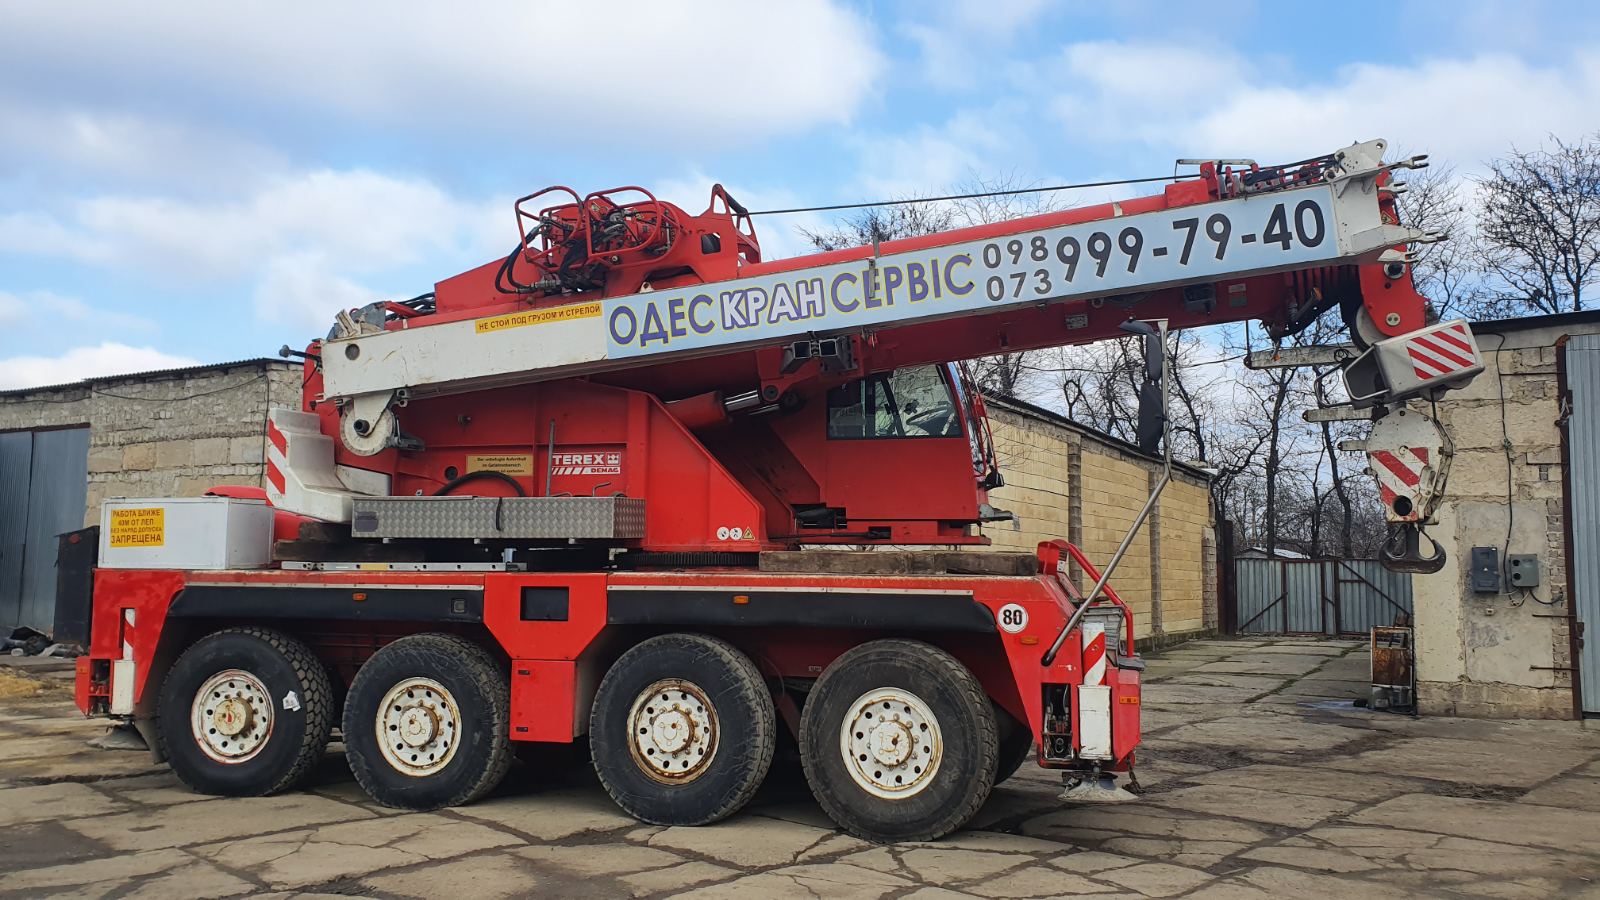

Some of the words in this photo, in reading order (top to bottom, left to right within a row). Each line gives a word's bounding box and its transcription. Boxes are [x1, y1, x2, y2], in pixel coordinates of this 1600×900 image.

[983, 236, 1049, 269] 098
[986, 268, 1052, 302] 073
[479, 322, 489, 331] НЕ
[511, 316, 527, 326] ПОД
[528, 311, 557, 323] ГРУЗОМ
[565, 303, 601, 317] СТРЕЛОЙ
[552, 454, 605, 465] TEREX
[112, 510, 137, 518] РАБОТА
[137, 509, 161, 517] БЛИЖЕ
[140, 518, 154, 526] ЛЕП
[111, 533, 162, 544] ЗАПРЕЩЕНА
[1002, 609, 1023, 626] 80
